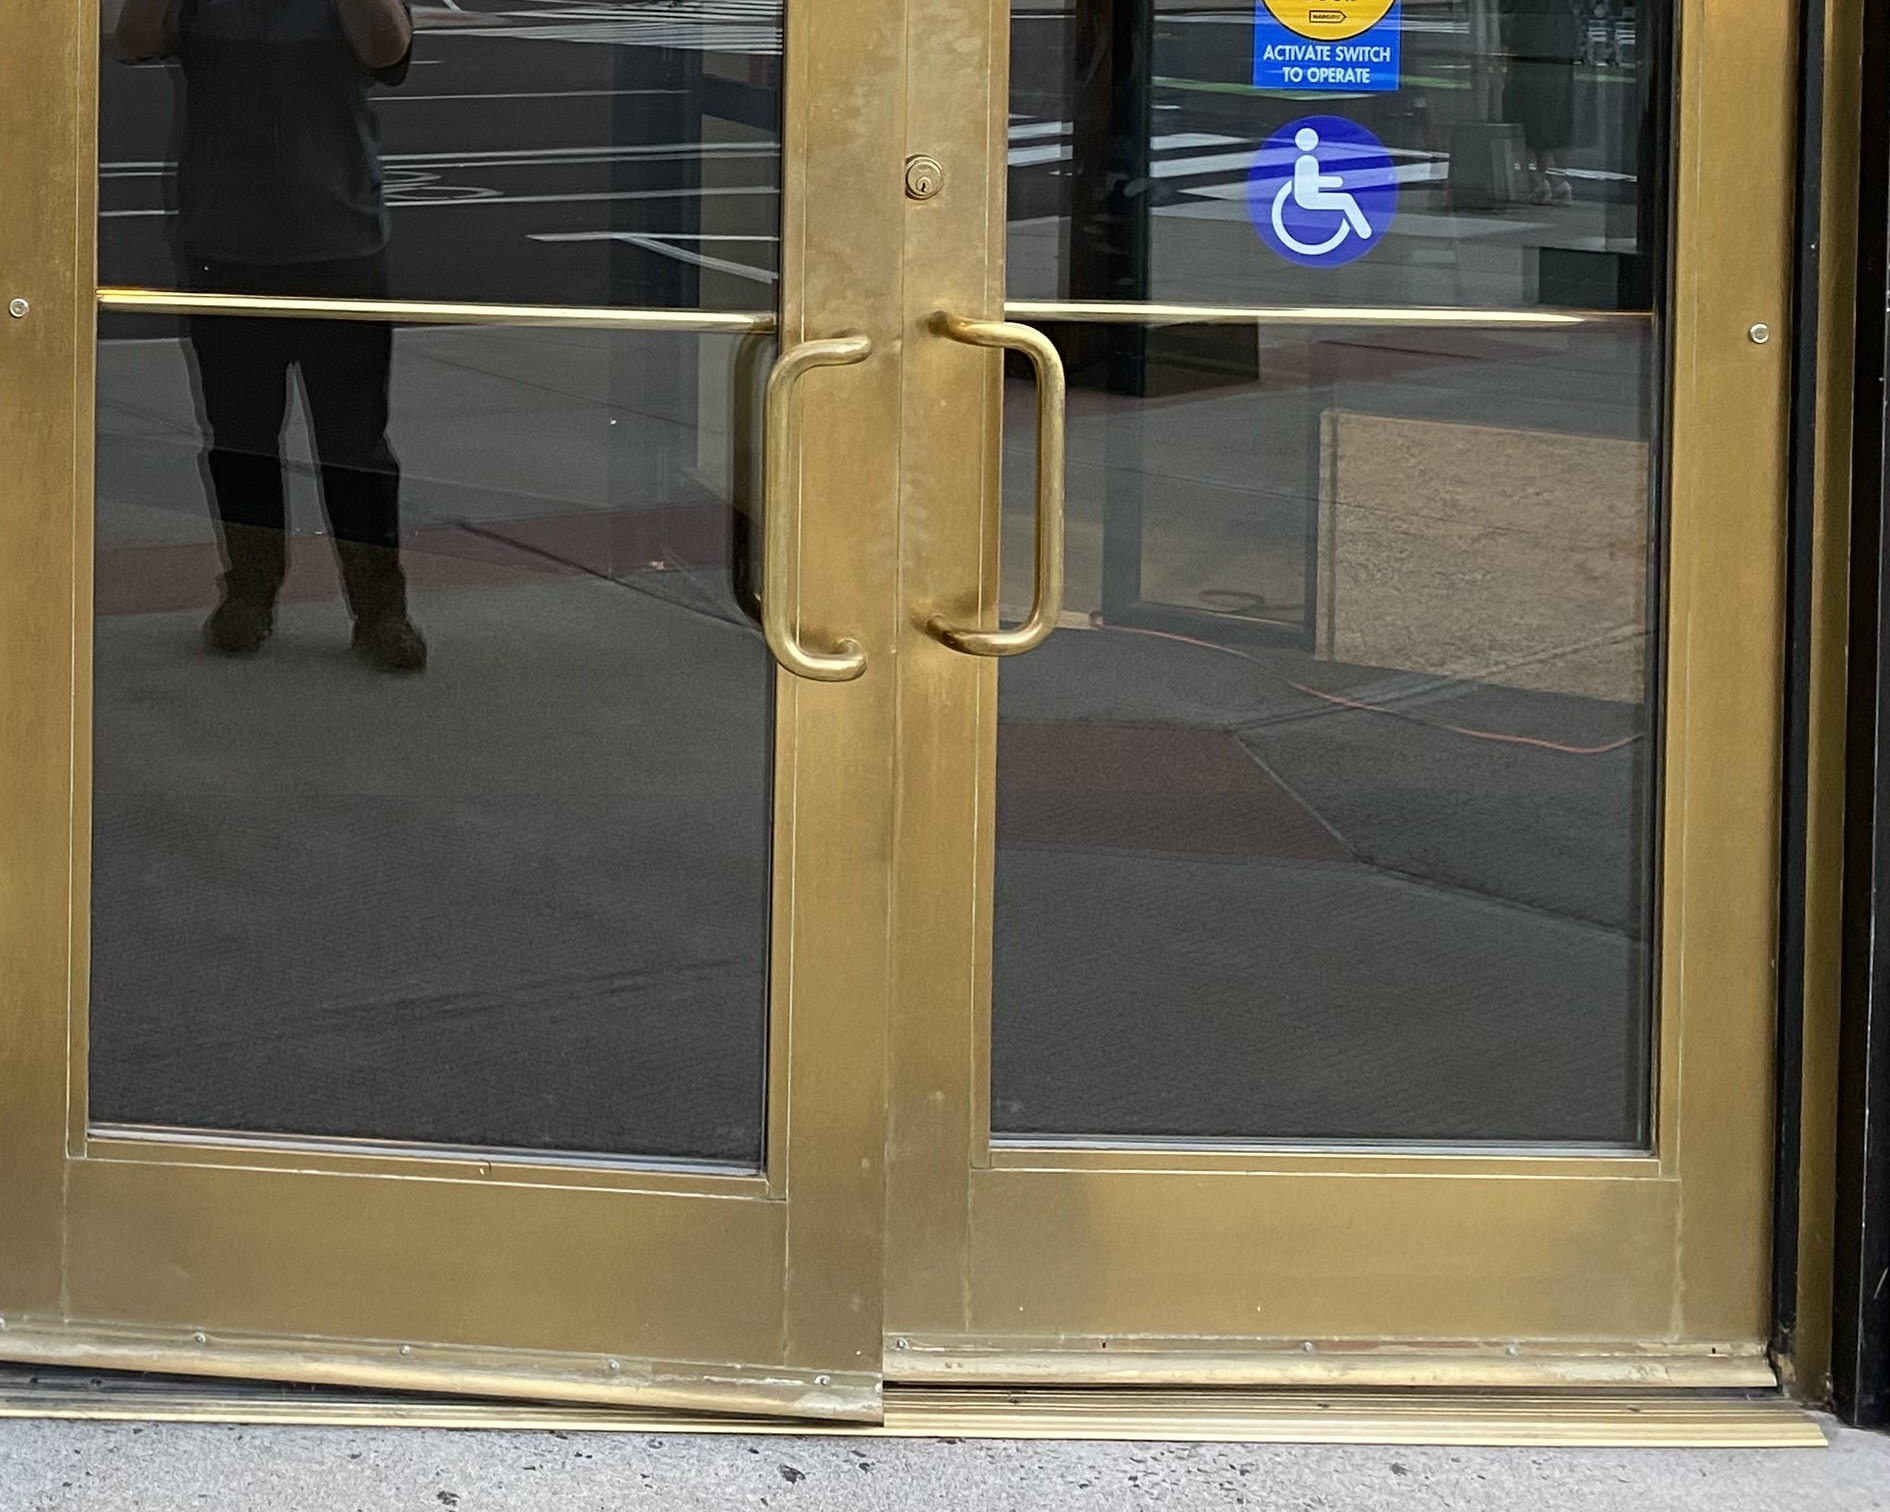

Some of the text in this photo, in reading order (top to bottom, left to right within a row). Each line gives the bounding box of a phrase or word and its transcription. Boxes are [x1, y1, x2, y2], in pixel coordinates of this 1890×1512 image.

[1263, 44, 1391, 63] ACTIVATE SWITCH
[1282, 66, 1371, 84] TO OPERATE
